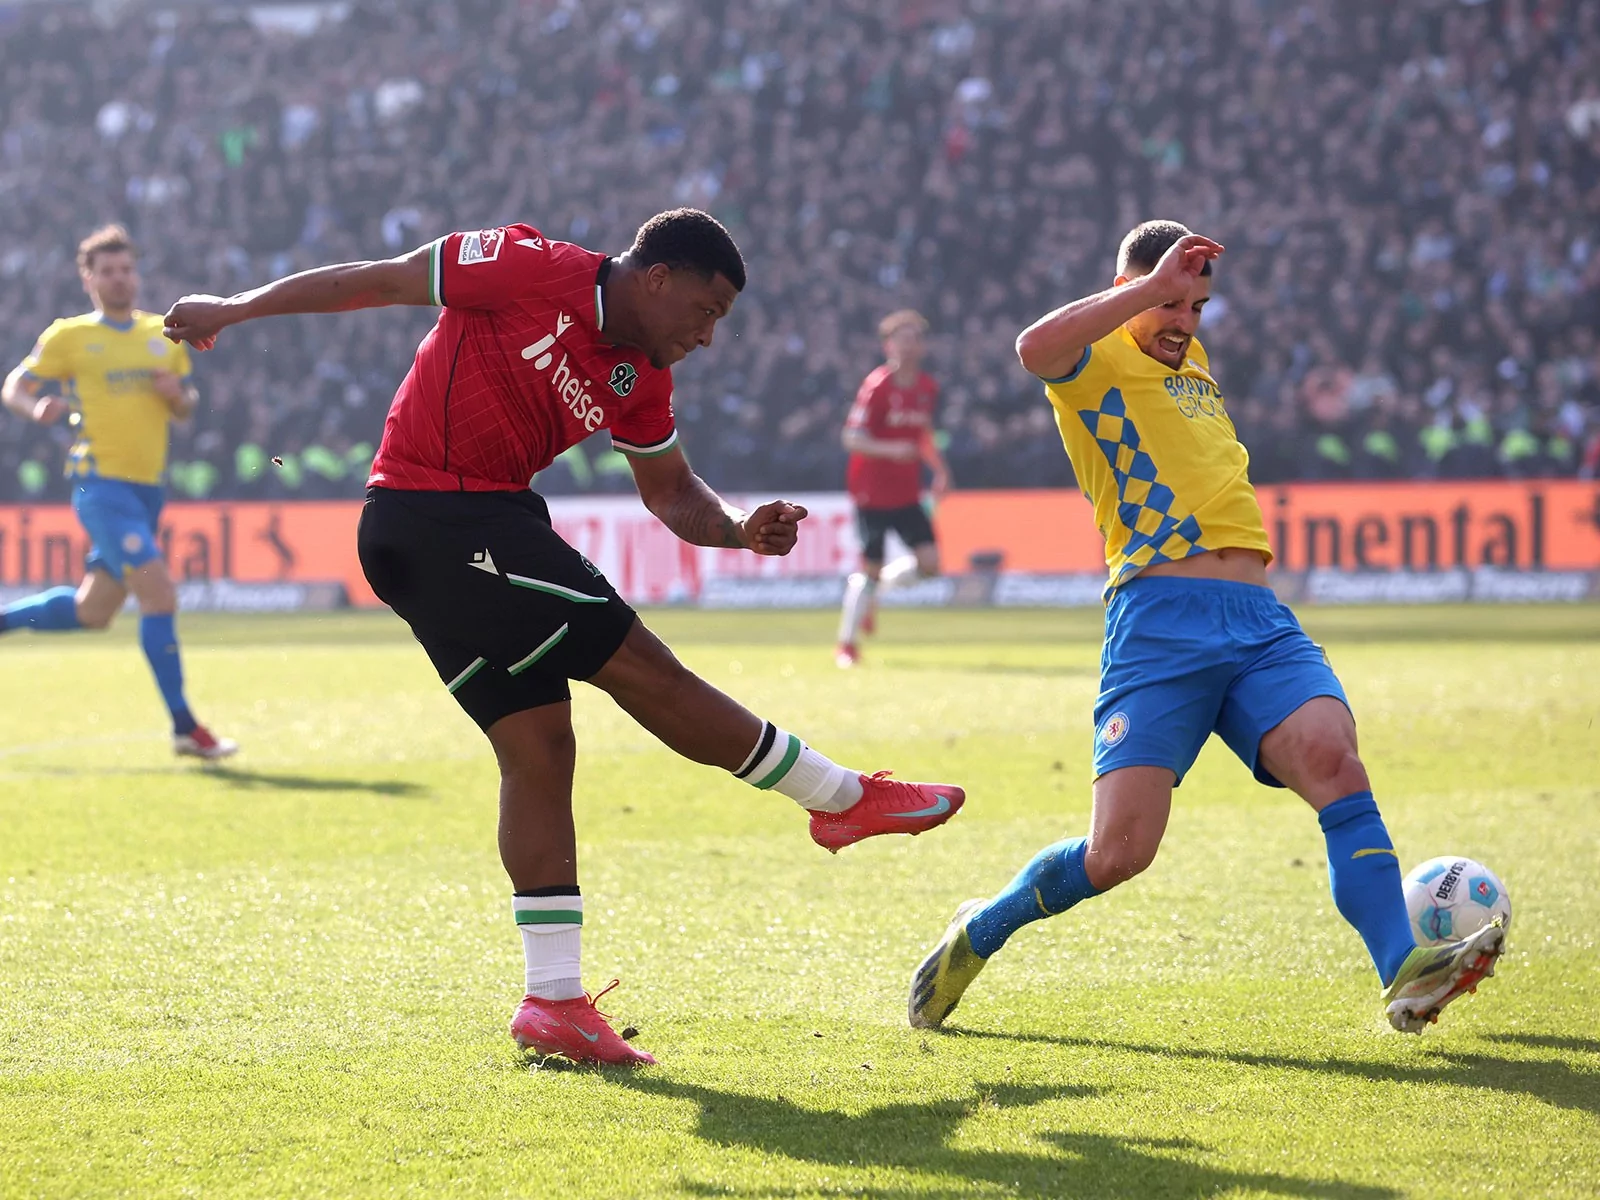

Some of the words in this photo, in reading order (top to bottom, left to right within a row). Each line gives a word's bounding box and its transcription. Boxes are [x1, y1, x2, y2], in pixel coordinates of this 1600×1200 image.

[552, 353, 605, 432] heise
[608, 362, 639, 396] 96
[1272, 486, 1547, 571] inental
[1435, 860, 1468, 900] DERBYST
